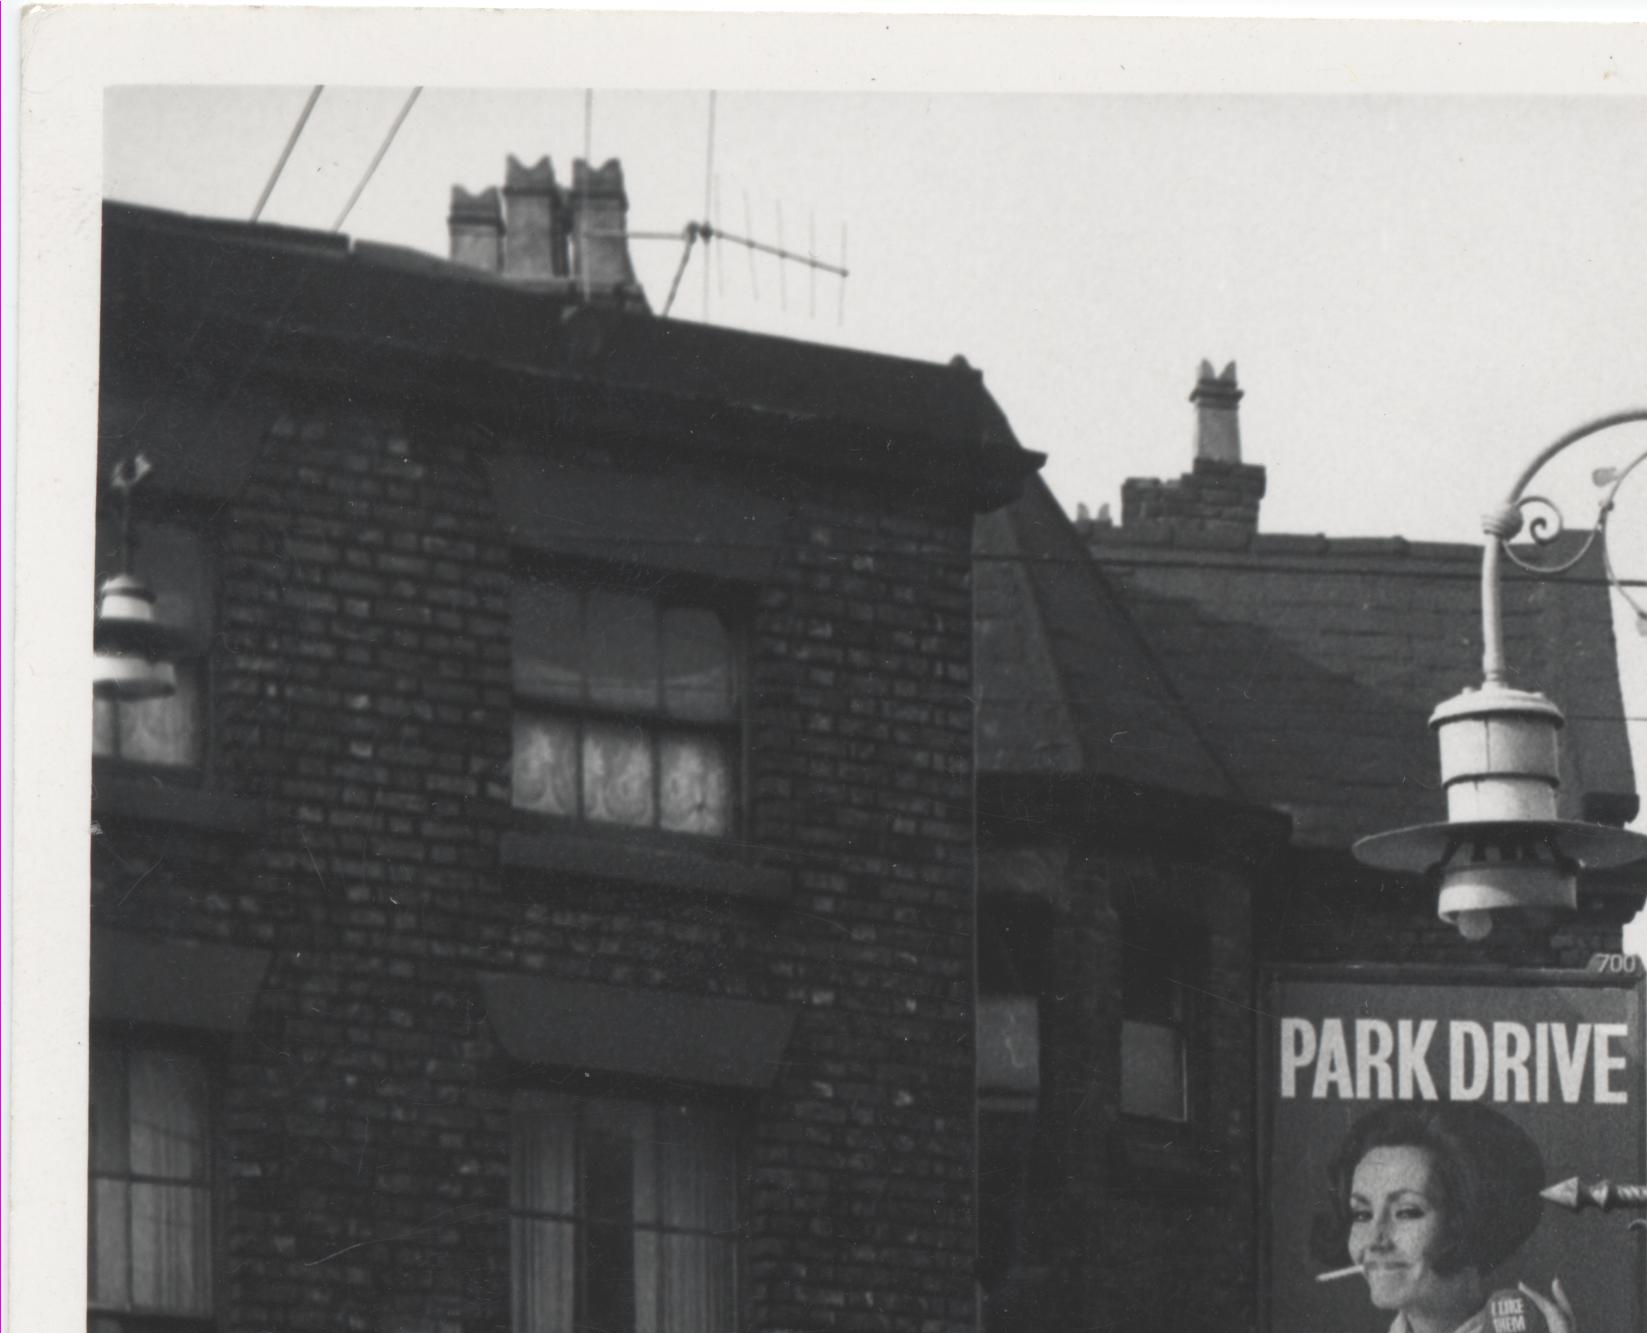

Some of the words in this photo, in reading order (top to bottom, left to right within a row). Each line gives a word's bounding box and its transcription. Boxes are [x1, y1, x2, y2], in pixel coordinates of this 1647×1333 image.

[1597, 955, 1636, 974] 700
[1281, 1017, 1439, 1101] PARK
[1449, 1020, 1628, 1104] DRIVE
